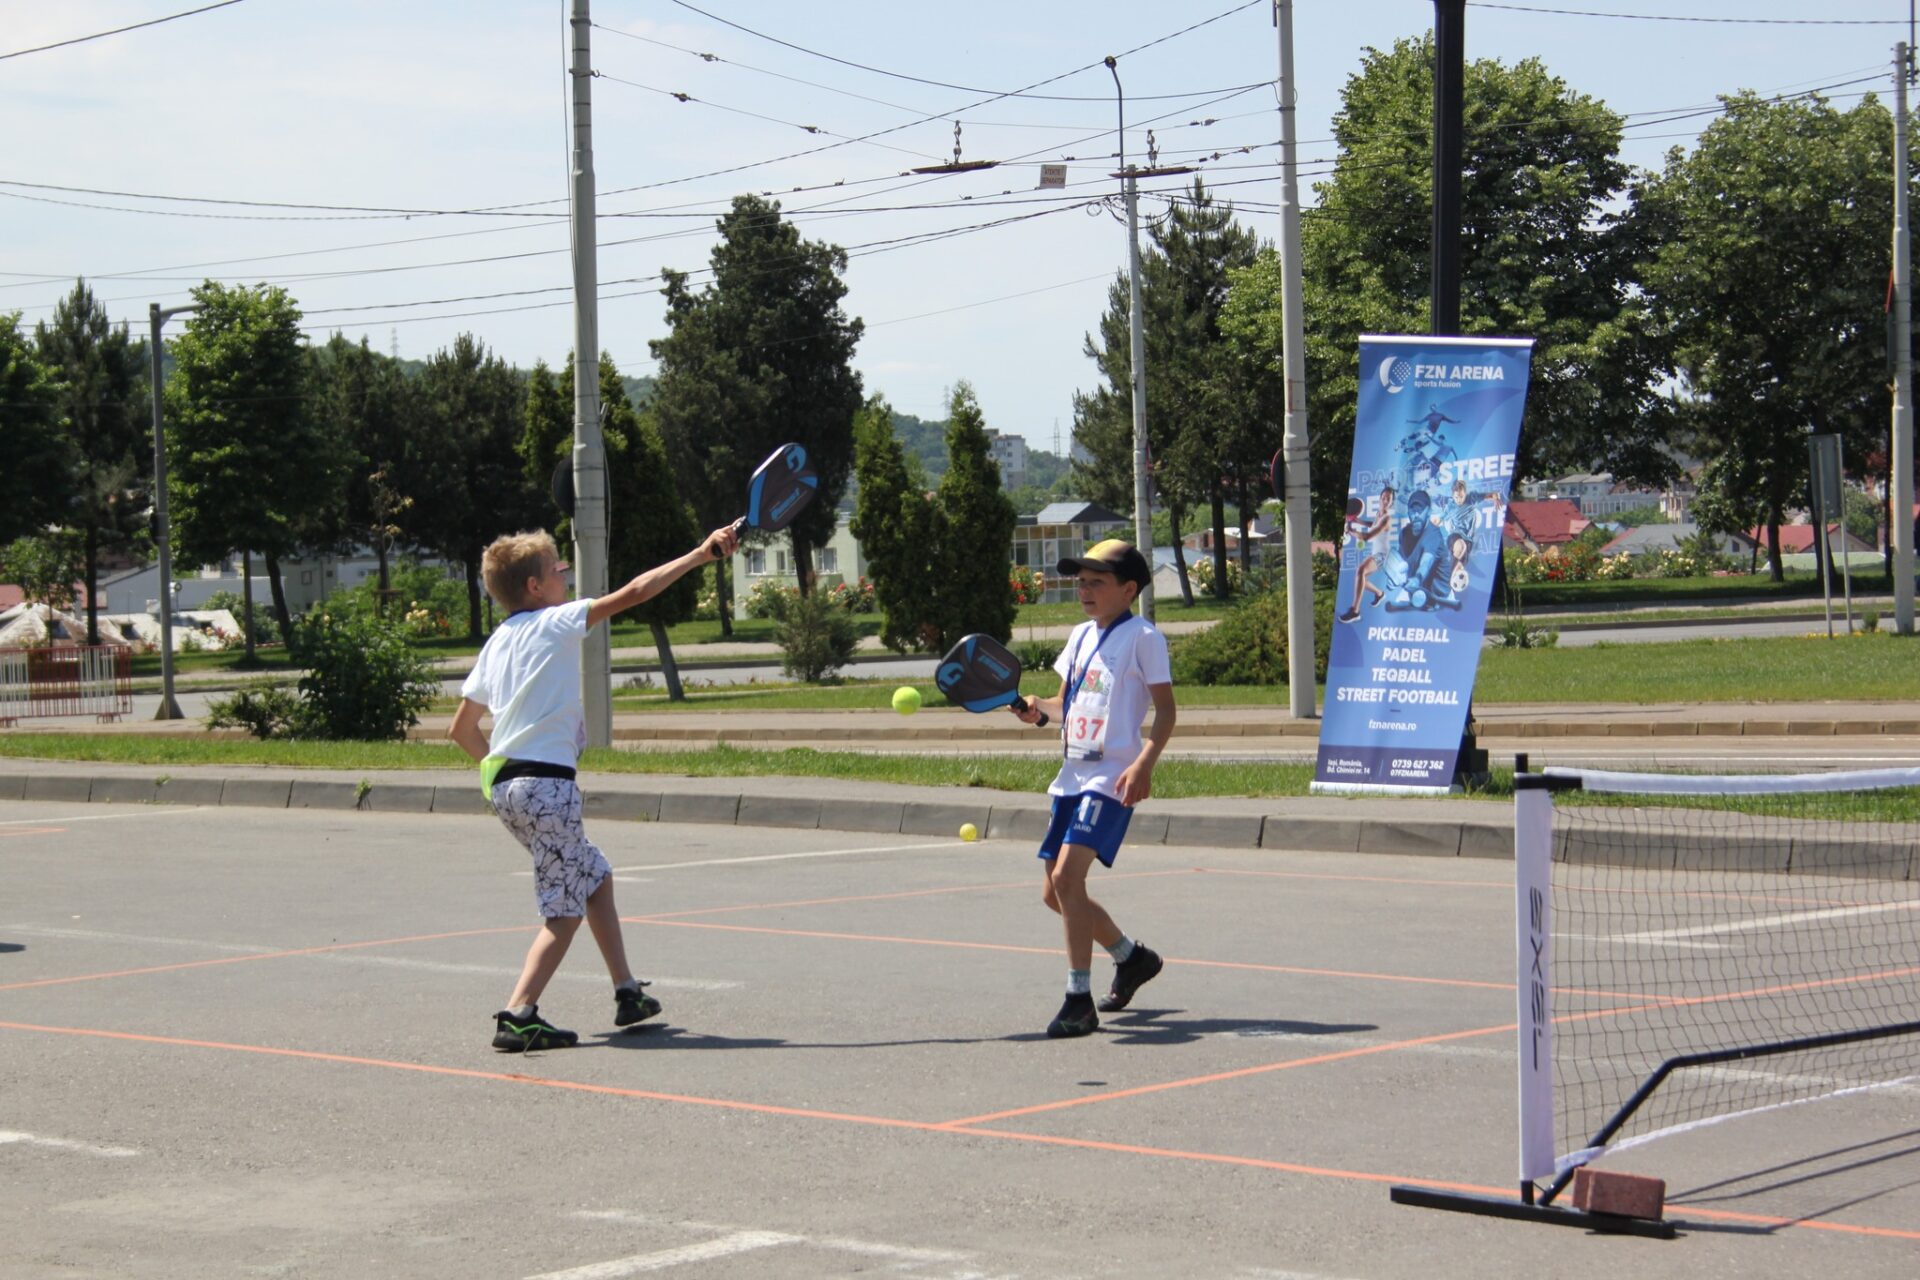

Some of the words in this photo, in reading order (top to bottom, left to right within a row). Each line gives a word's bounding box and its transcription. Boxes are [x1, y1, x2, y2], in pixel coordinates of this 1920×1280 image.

[1414, 364, 1447, 379] FZN
[1450, 365, 1504, 380] ARENA
[1414, 380, 1437, 388] sports
[1438, 380, 1461, 388] fusion
[1367, 626, 1450, 643] PICKLEBALL
[1382, 647, 1427, 663] PADEL
[1371, 667, 1432, 684] TEQBALL
[1336, 687, 1386, 702] STREET
[1388, 689, 1459, 705] FOOTBALL
[1368, 719, 1417, 731] fznarena.ro
[1392, 759, 1412, 768] 0739
[1413, 760, 1428, 769] 627
[1428, 760, 1445, 770] 362
